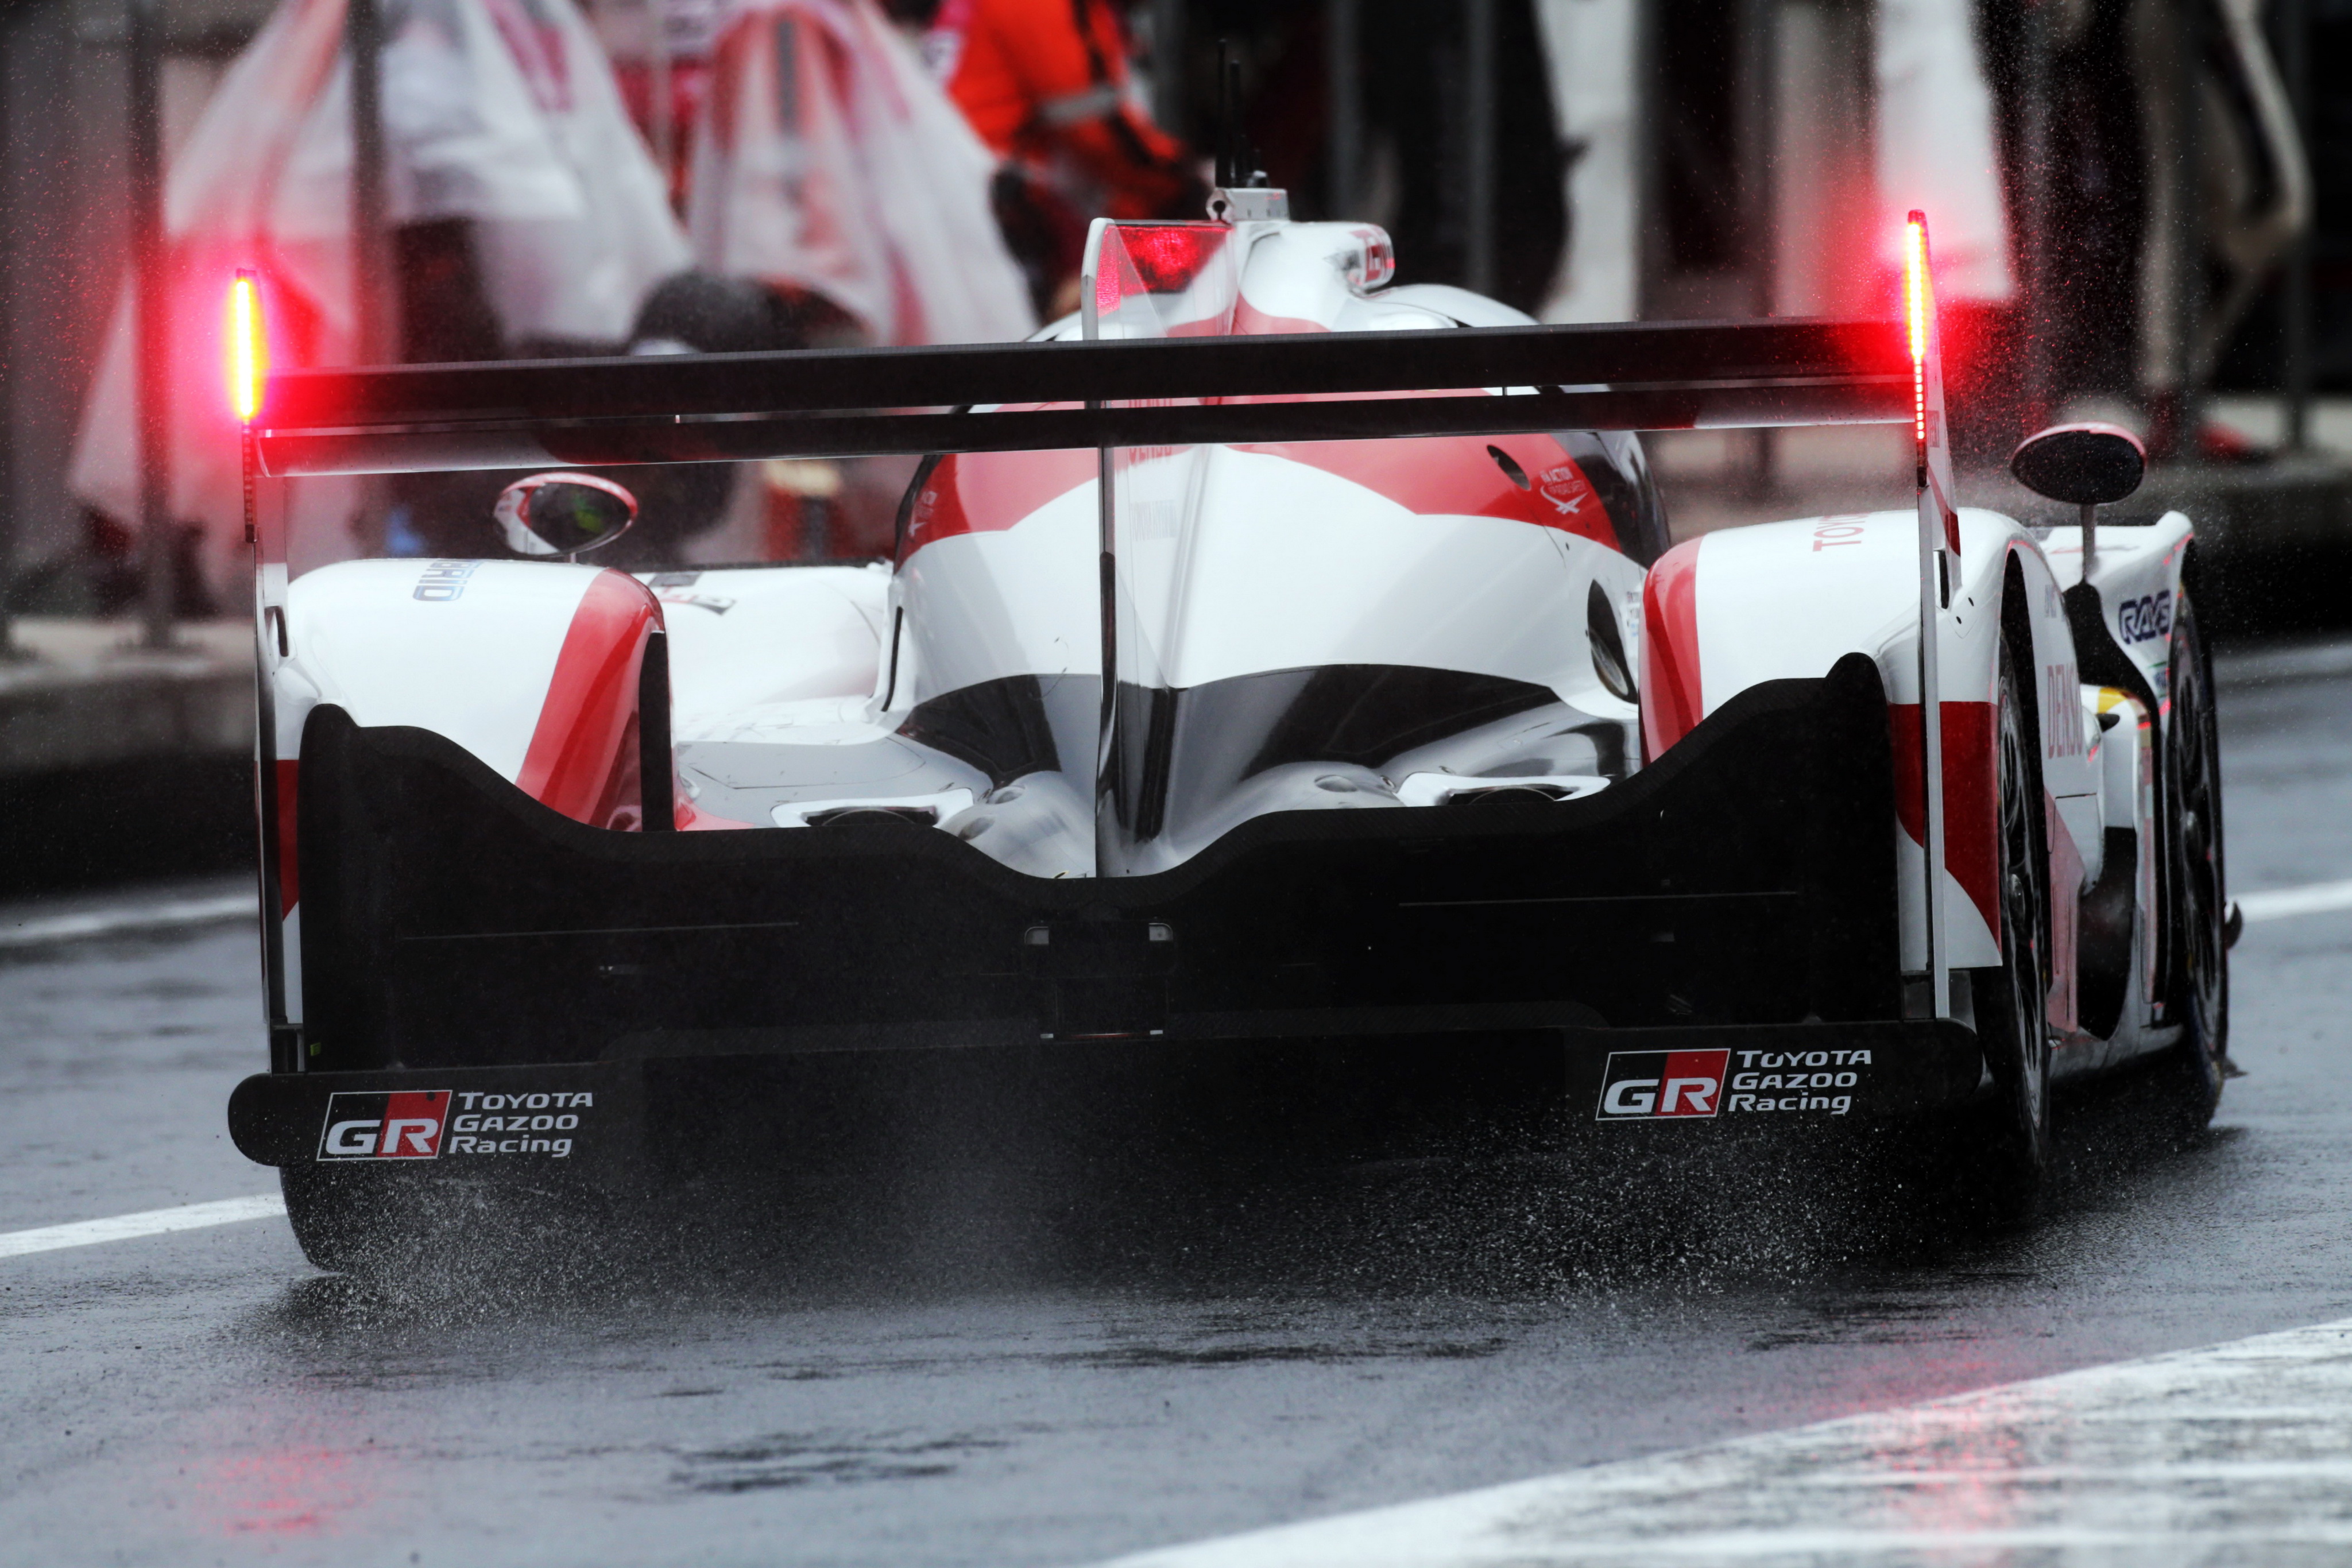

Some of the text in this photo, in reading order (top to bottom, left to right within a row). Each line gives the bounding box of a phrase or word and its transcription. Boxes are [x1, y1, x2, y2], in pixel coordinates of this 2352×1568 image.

[2119, 589, 2170, 644] RAYS
[1736, 1050, 1872, 1068] TOYOTA
[1732, 1071, 1858, 1089] GAZOO
[458, 1092, 593, 1110] TOYOTA
[1604, 1077, 1717, 1114] GR
[1728, 1092, 1851, 1115] Racing
[453, 1114, 579, 1132] GAZOO
[325, 1118, 439, 1155] GR
[448, 1135, 572, 1158] Racing
